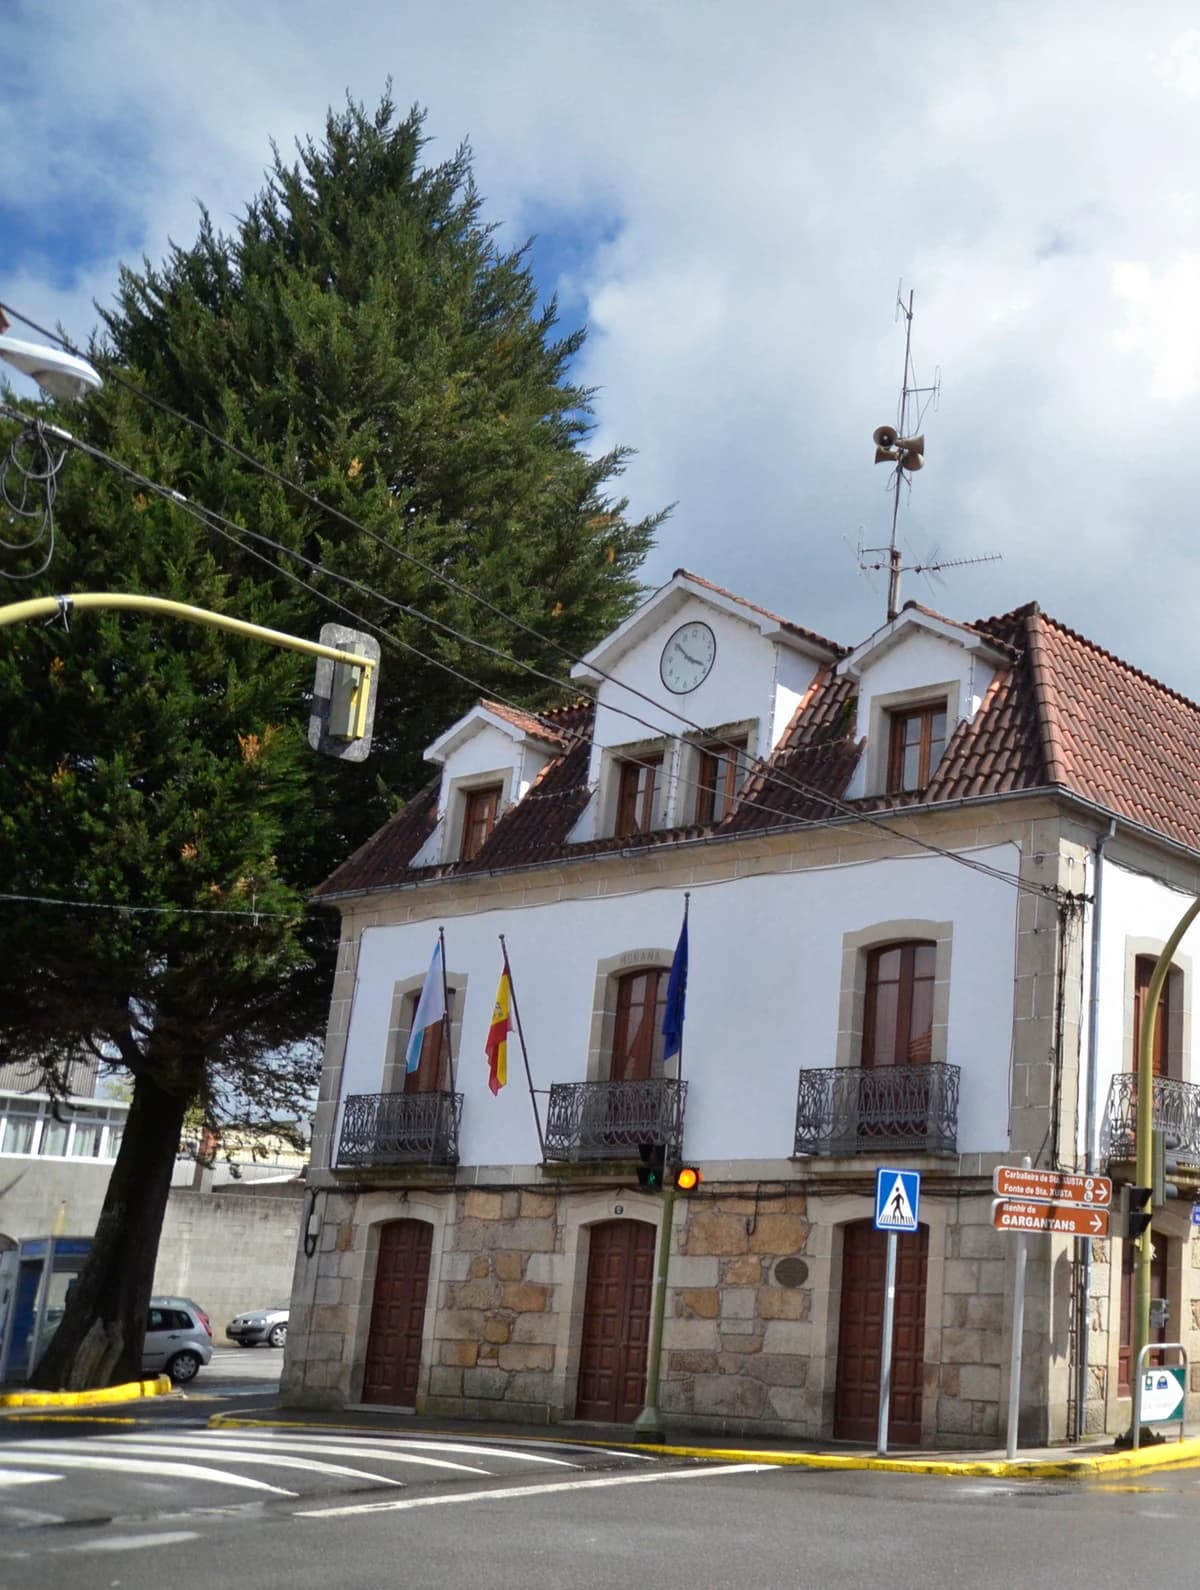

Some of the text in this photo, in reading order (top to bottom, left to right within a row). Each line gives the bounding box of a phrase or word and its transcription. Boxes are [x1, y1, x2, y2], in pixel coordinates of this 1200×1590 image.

[1040, 1174, 1048, 1182] de
[1062, 1176, 1084, 1187] XUSTA
[1004, 1183, 1023, 1193] Fonte
[1025, 1186, 1034, 1194] de
[1049, 1188, 1073, 1199] XUSTA
[1027, 1205, 1036, 1213] de
[1001, 1214, 1076, 1231] GARGANTANS
